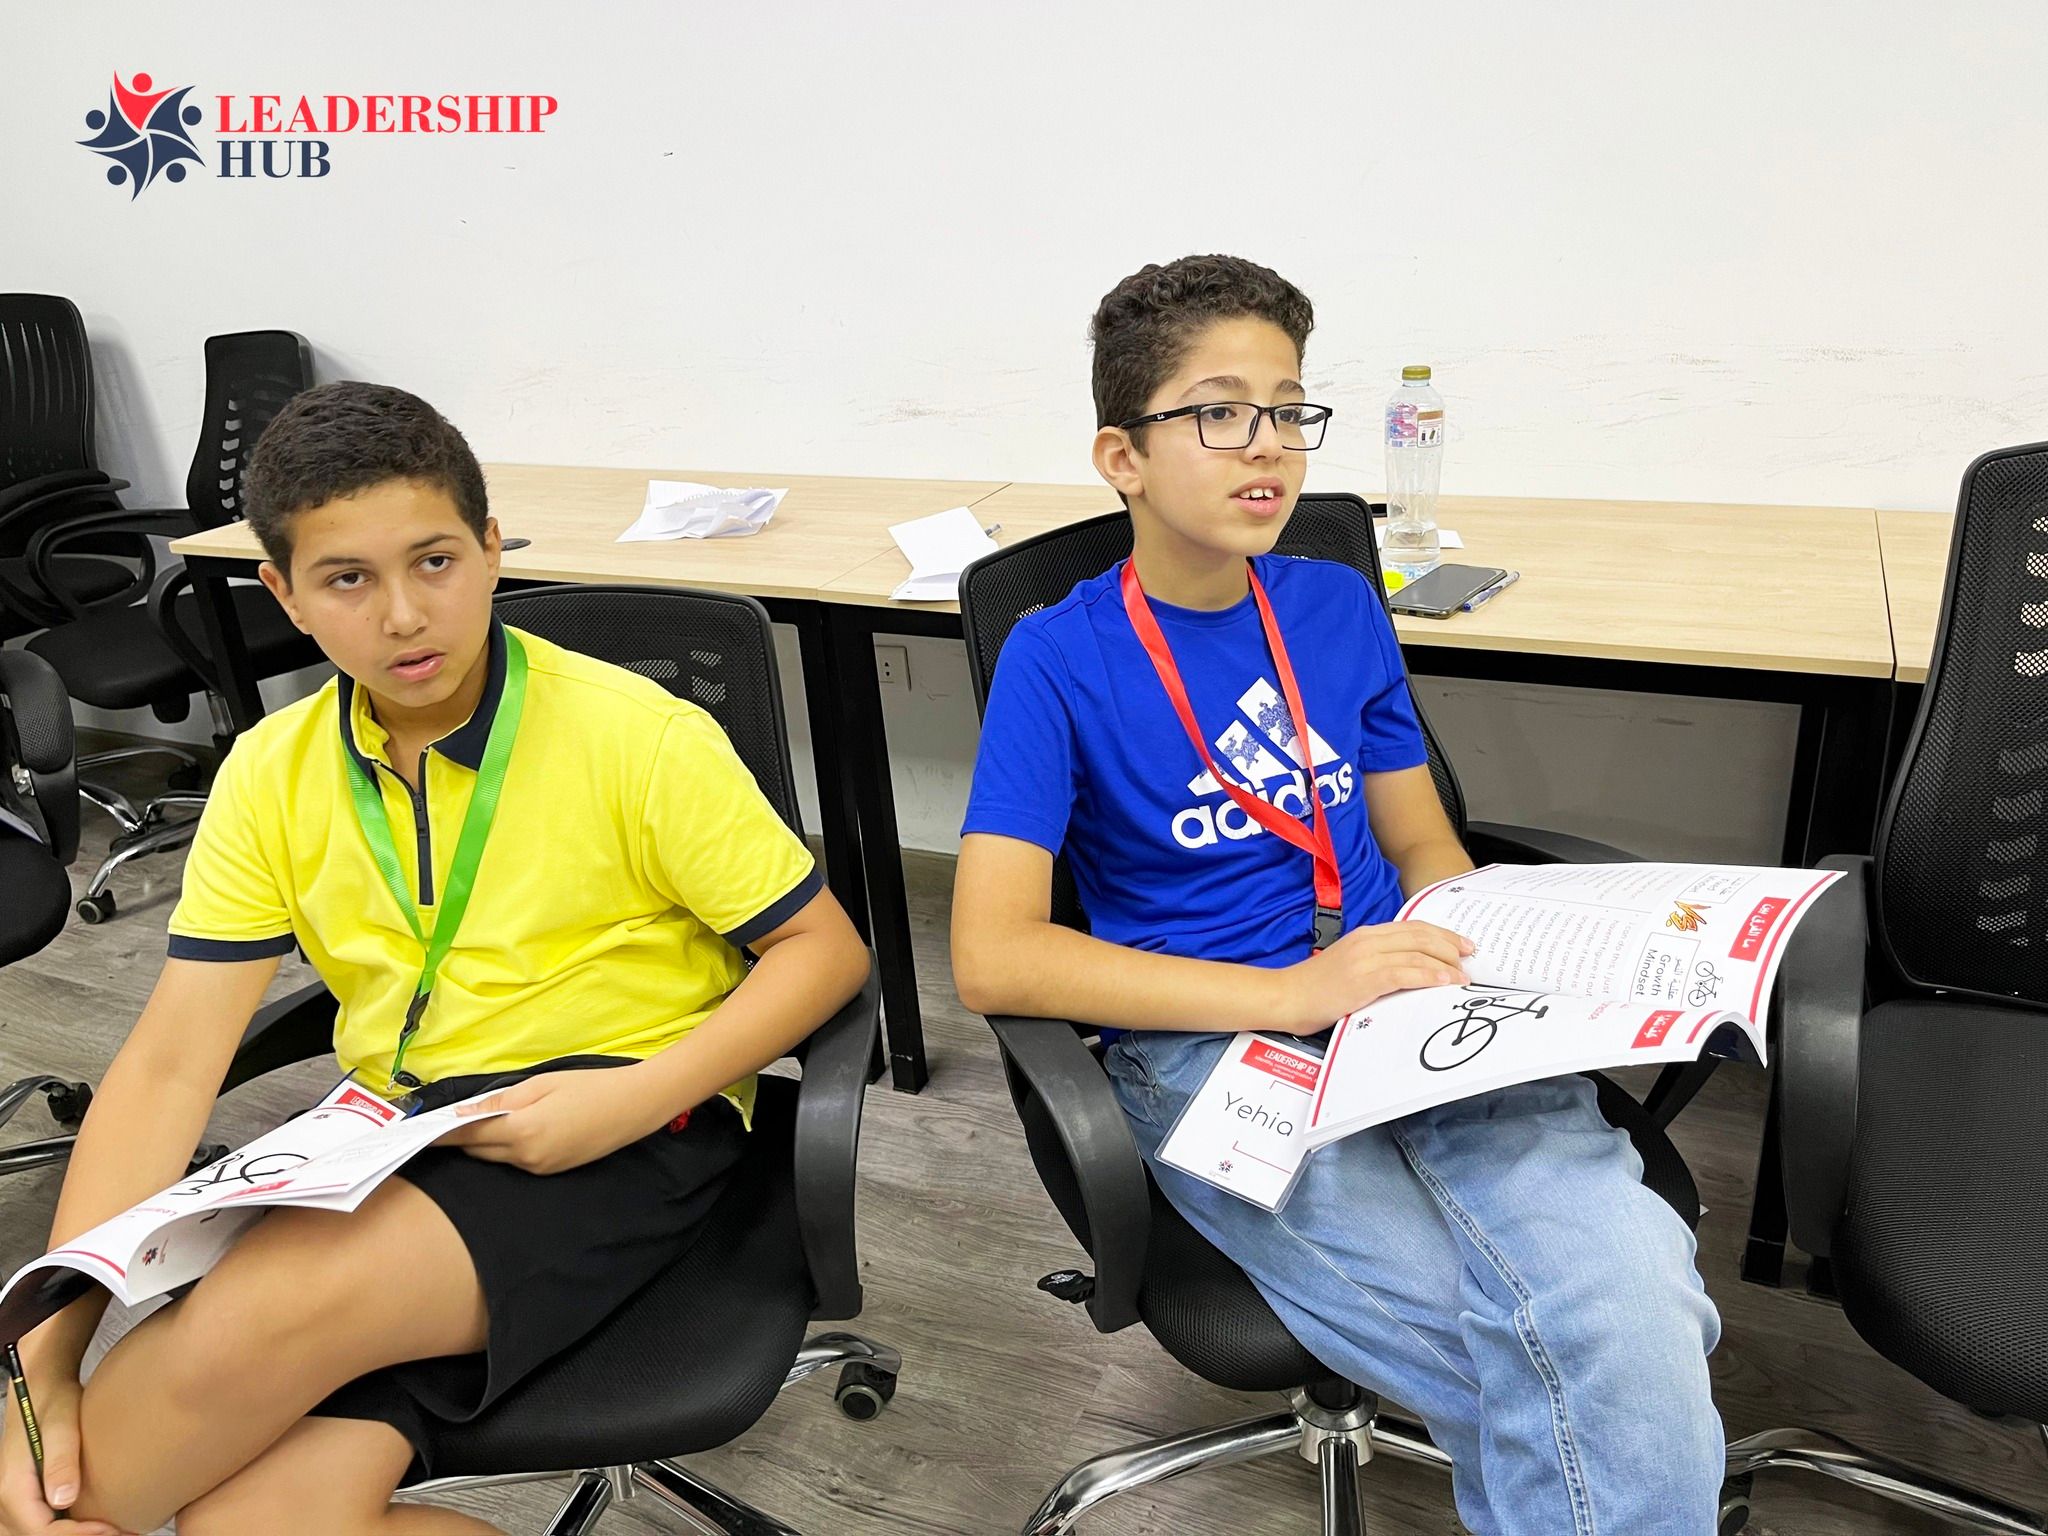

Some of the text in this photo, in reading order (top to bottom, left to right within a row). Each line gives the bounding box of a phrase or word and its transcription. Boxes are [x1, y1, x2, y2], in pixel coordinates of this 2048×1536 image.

[1498, 918, 1508, 931] and
[1562, 913, 1576, 928] from
[1567, 916, 1589, 945] anything
[1476, 919, 1495, 947] inspired
[1488, 932, 1500, 954] effort
[1508, 932, 1518, 940] by
[1621, 926, 1632, 939] can
[1496, 942, 1512, 972] putting
[1518, 948, 1525, 957] or
[1616, 941, 1625, 951] do
[1528, 941, 1543, 974] improve
[1541, 941, 1559, 982] approach
[1560, 951, 1570, 966] can
[1574, 956, 1586, 978] there
[1591, 947, 1606, 971] figure
[1510, 960, 1521, 984] talent
[1555, 969, 1566, 992] learn
[1635, 949, 1658, 995] Mindset
[1651, 955, 1671, 996] Growth
[1571, 981, 1578, 989] is
[1602, 976, 1614, 994] just
[1264, 1049, 1307, 1070] LEADERSHIP
[1224, 1091, 1294, 1137] Yehia
